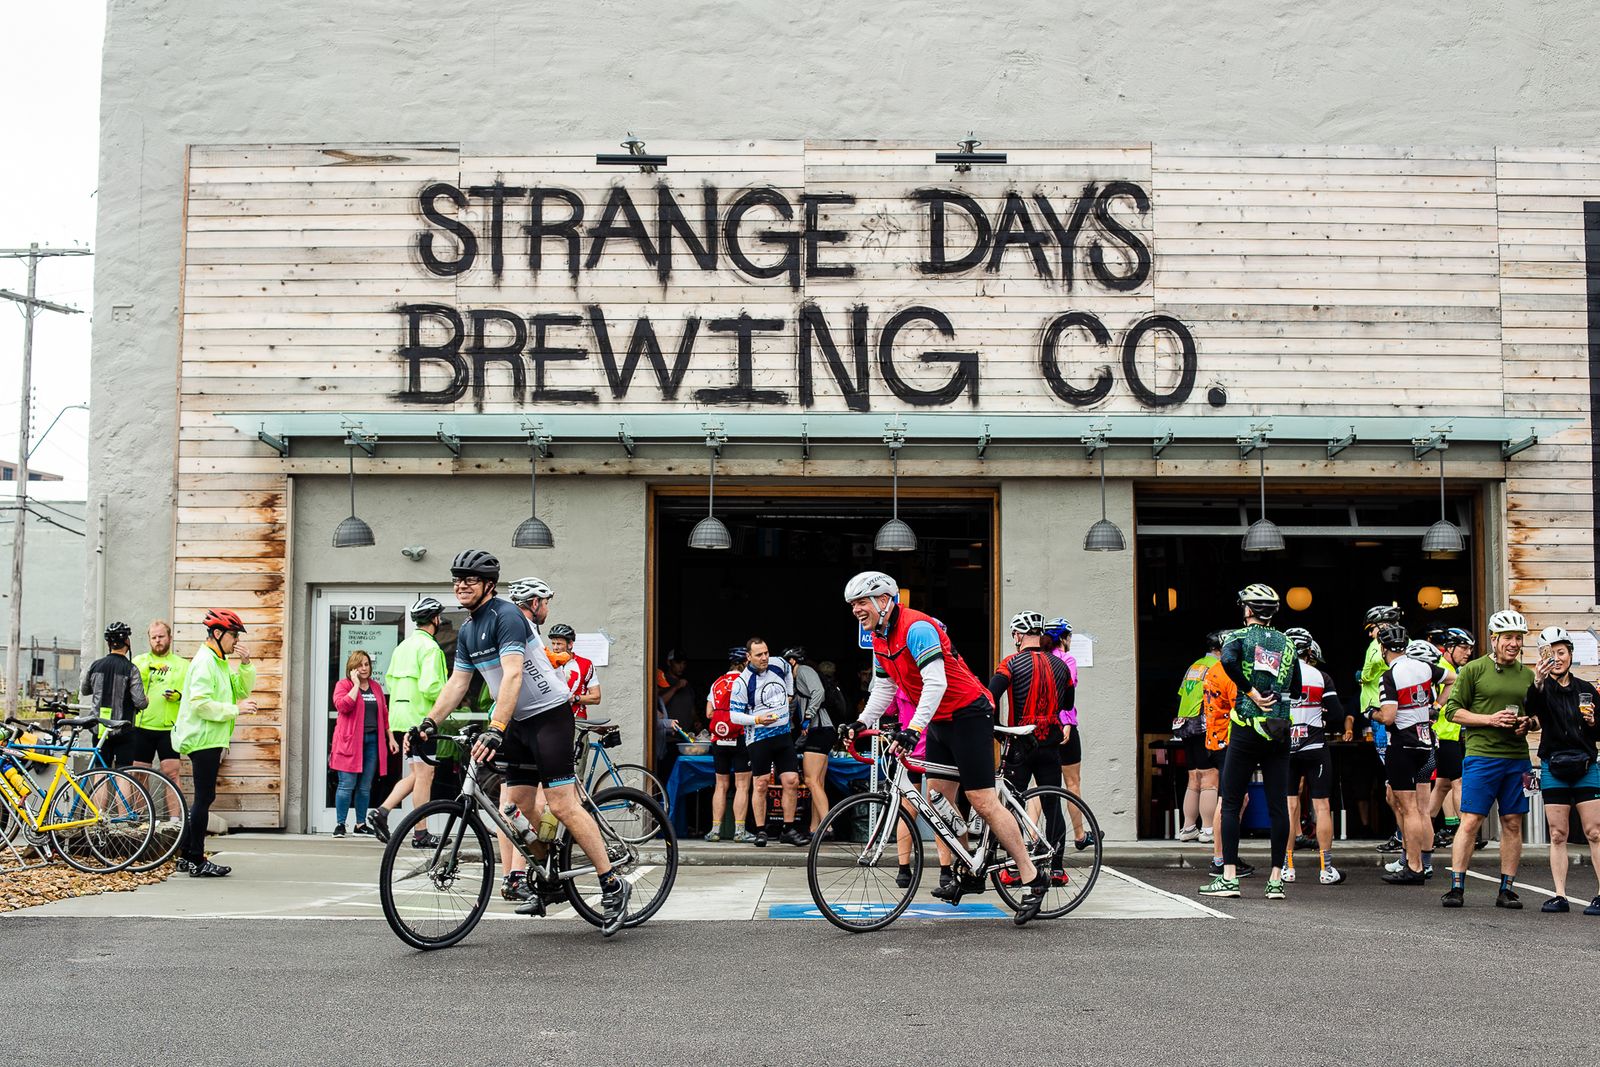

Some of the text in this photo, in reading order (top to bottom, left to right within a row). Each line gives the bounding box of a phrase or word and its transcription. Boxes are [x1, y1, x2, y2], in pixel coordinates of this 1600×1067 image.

[419, 179, 1152, 288] STRANGE DAYS
[400, 303, 1228, 410] BREWING CO.
[350, 606, 374, 620] 316
[523, 659, 552, 695] RIDE ON
[905, 789, 955, 840] FELT
